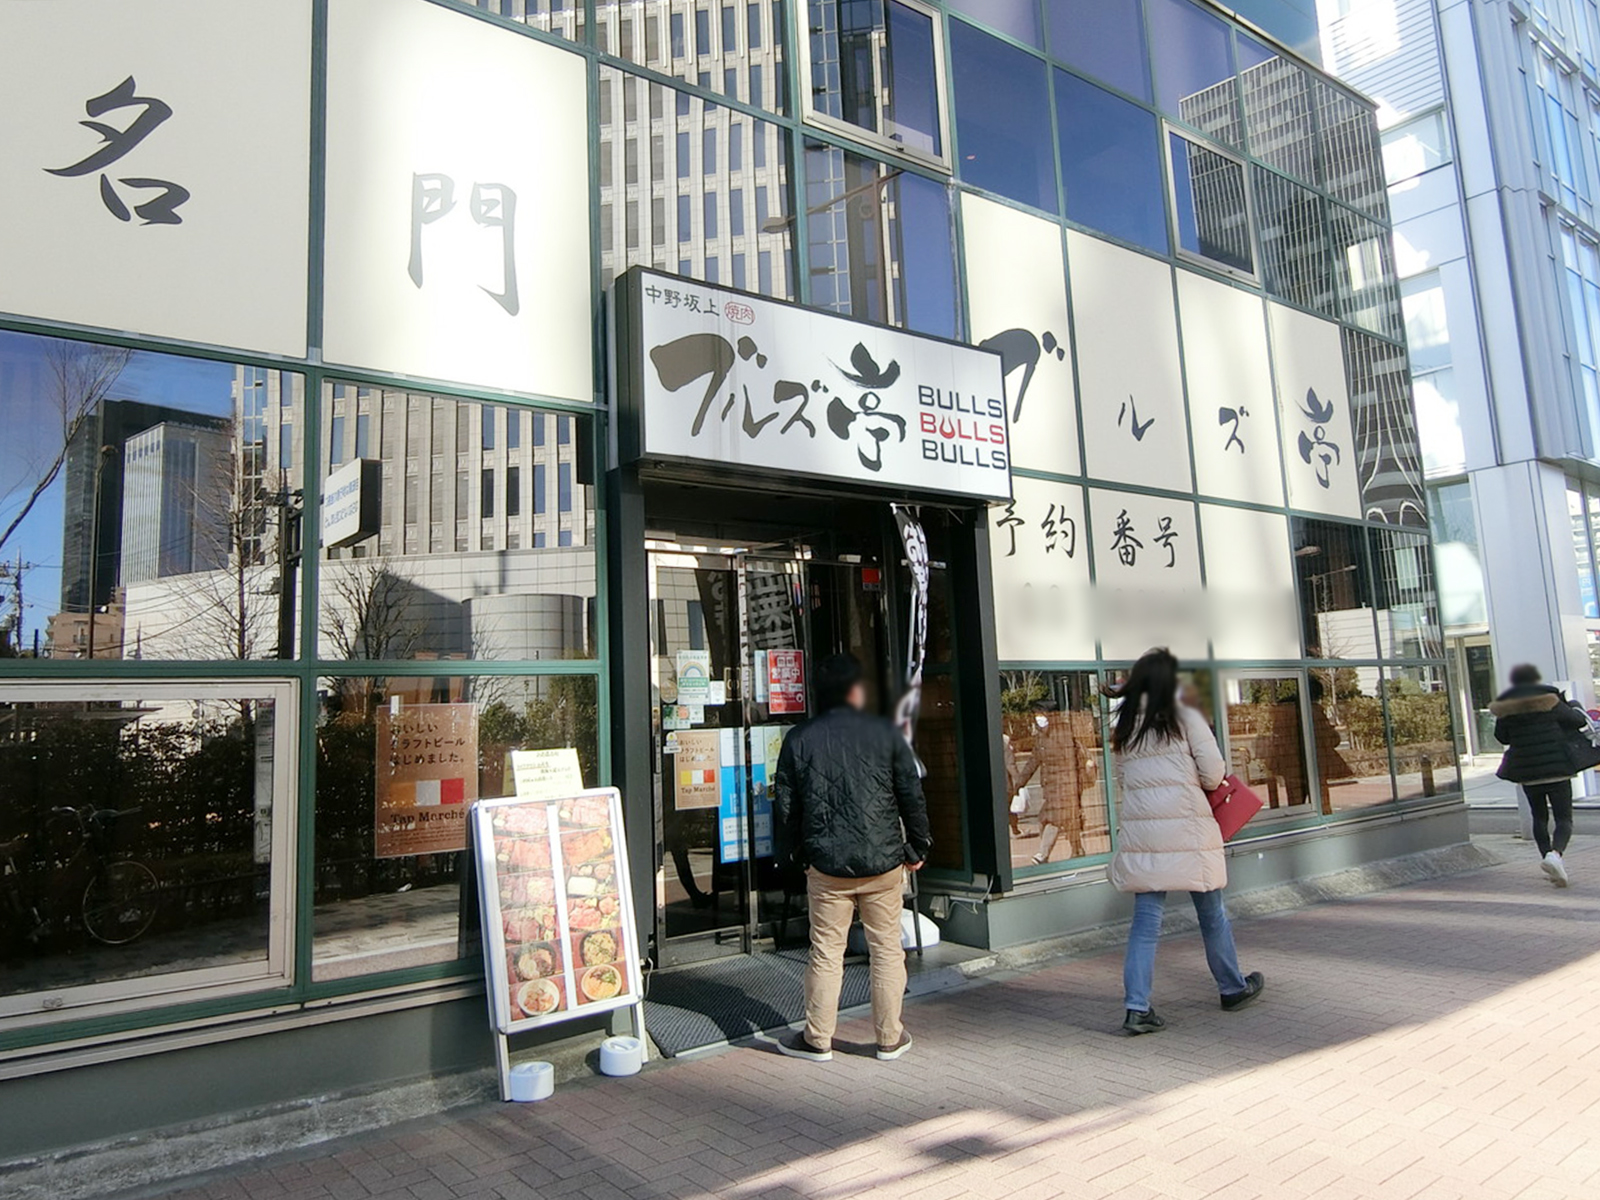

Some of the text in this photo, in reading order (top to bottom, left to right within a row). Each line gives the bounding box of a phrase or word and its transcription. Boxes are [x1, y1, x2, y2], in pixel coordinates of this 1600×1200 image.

[43, 75, 520, 317] 名門
[645, 284, 720, 317] 中野坂上
[725, 303, 753, 322] 焼肉
[649, 333, 907, 472] ブルズ亭
[917, 384, 1003, 419] BULLS
[978, 327, 1341, 489] ブルズ亭
[919, 411, 1005, 445] BULLS
[922, 439, 1007, 471] BULLS
[996, 499, 1179, 569] 予約番号
[390, 807, 465, 824] Tap Marché
